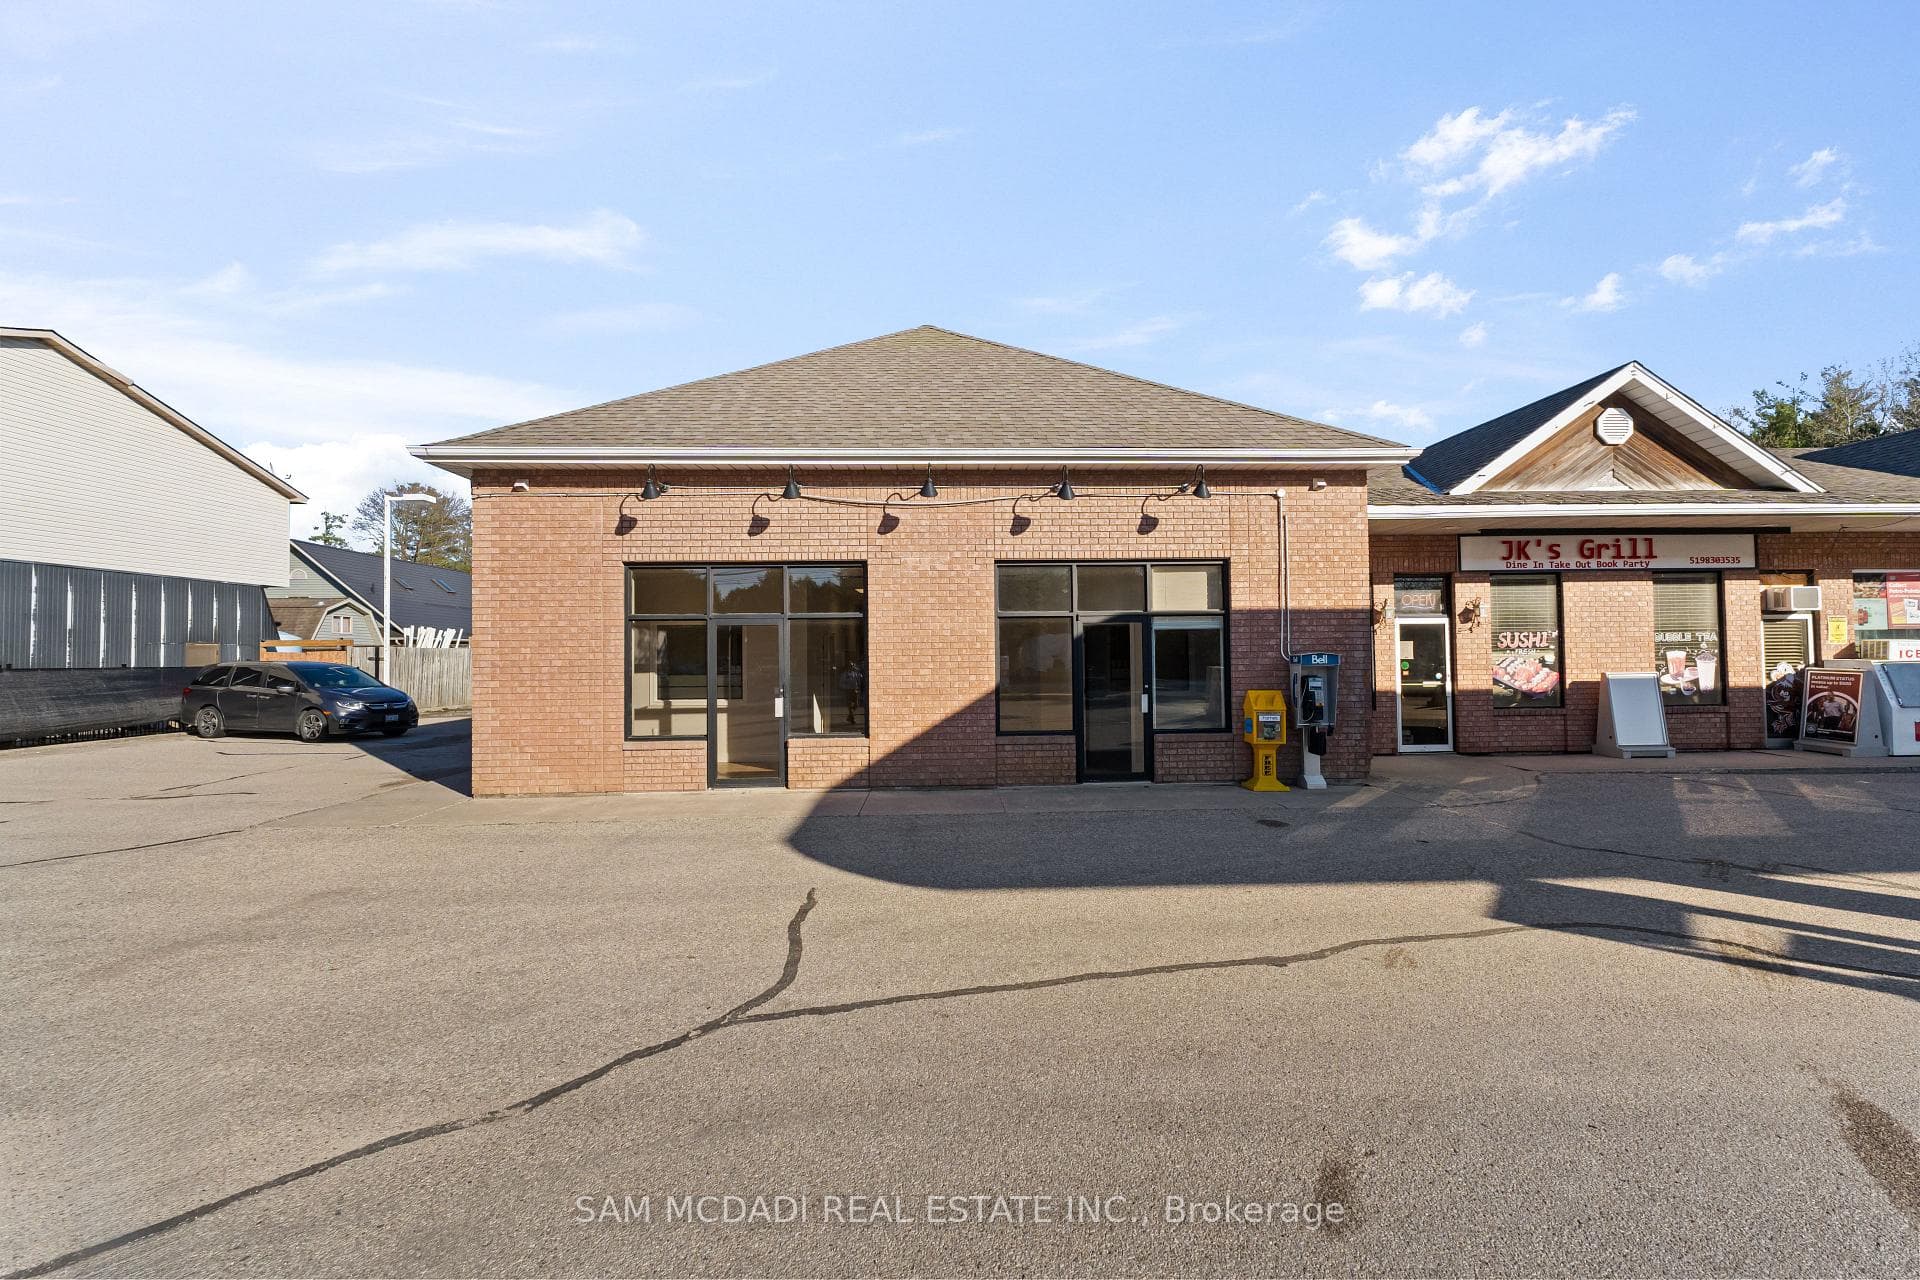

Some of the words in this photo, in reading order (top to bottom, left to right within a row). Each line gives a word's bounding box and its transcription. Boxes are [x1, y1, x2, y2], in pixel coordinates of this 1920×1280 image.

[1501, 539, 1561, 561] JK's
[1578, 537, 1658, 560] Grill
[1505, 561, 1528, 569] Dine
[1532, 561, 1544, 569] In
[1548, 561, 1571, 569] Take
[1575, 561, 1592, 569] Out
[1596, 561, 1618, 569] Book
[1623, 560, 1651, 569] Party
[1401, 594, 1437, 607] OPEN
[1497, 631, 1550, 649] SUSHI
[1655, 632, 1692, 642] BUBBLE
[1696, 632, 1718, 642] TEA
[1312, 654, 1328, 665] Bell
[1899, 649, 1920, 659] ICE
[1264, 755, 1272, 777] FREE
